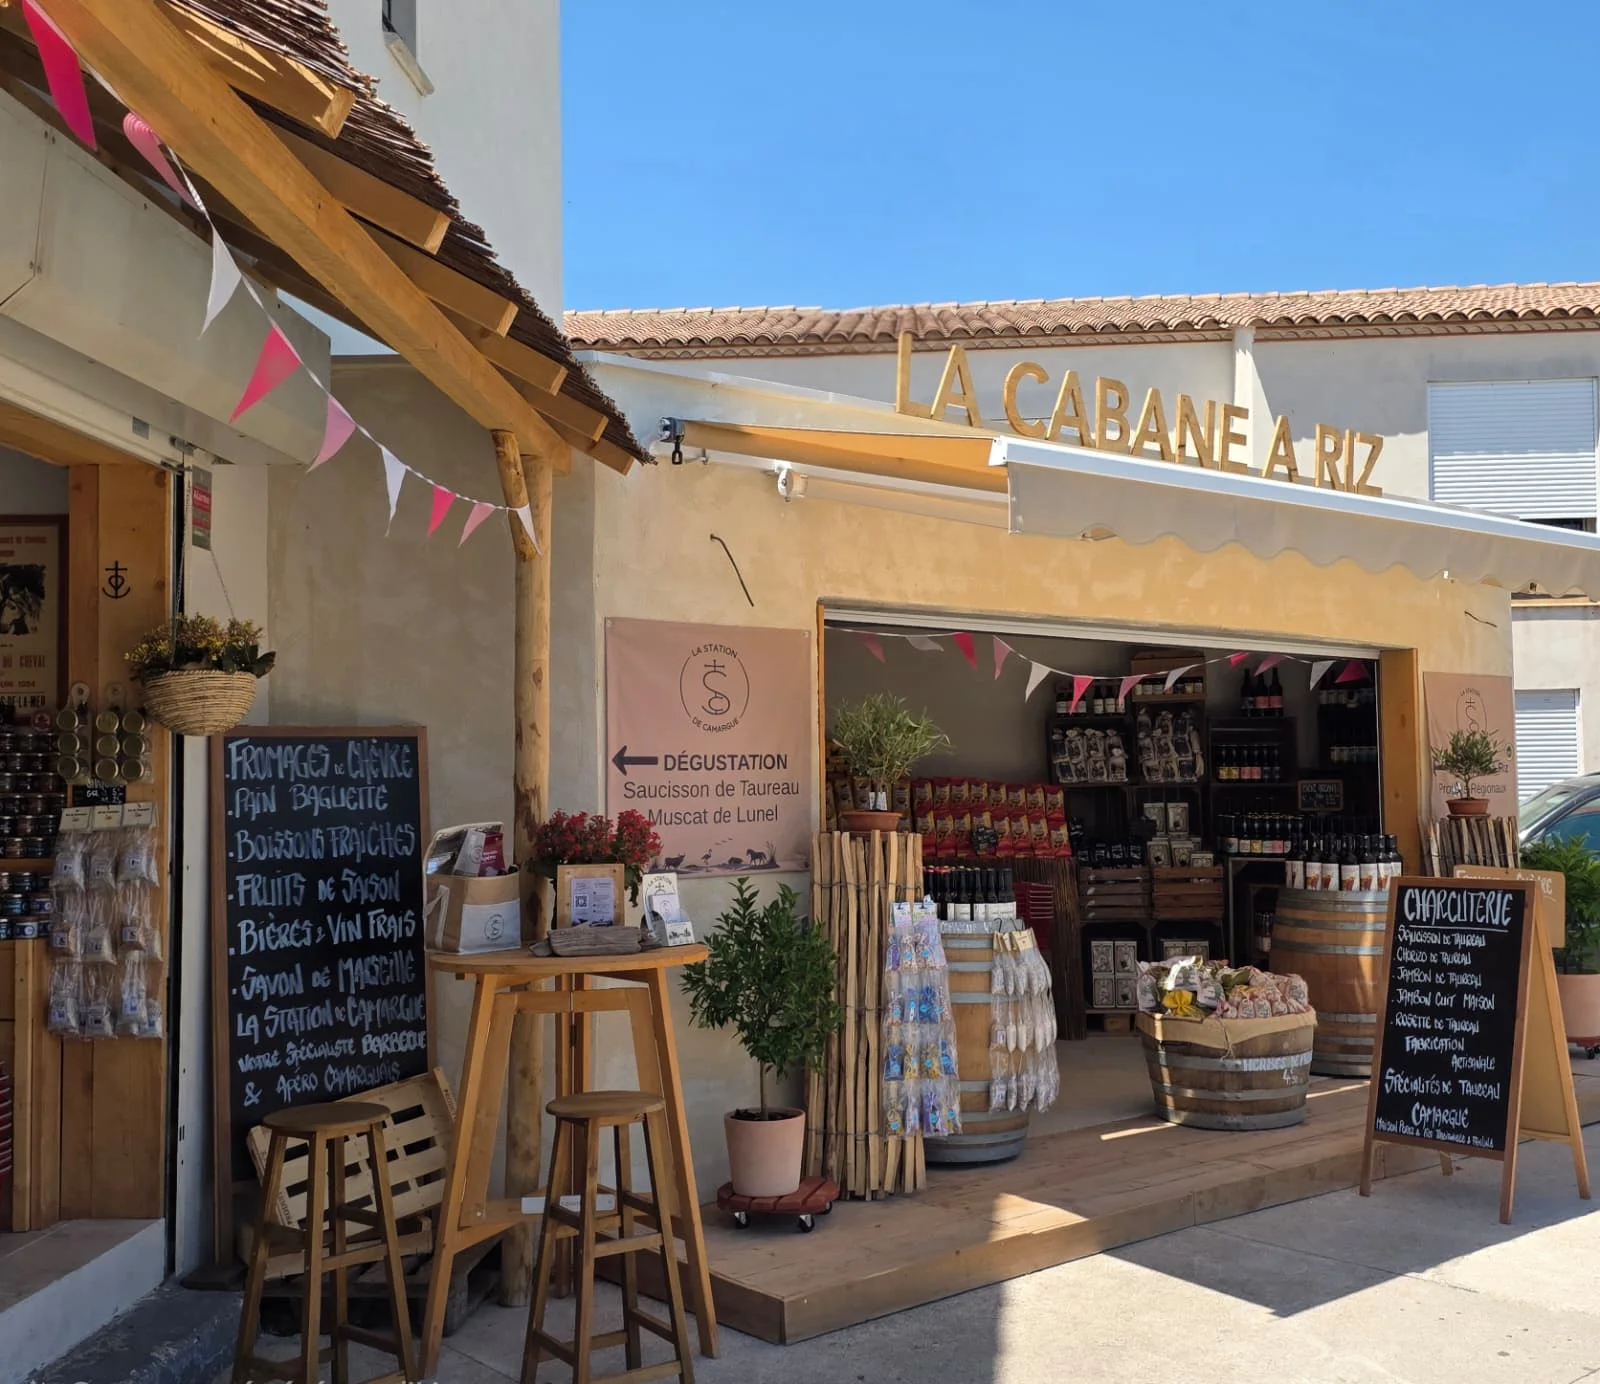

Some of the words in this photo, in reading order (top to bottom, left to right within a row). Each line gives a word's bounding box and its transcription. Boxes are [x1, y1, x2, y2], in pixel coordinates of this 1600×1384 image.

[895, 332, 983, 428] LA
[1003, 361, 1249, 475] CABANE
[1262, 415, 1299, 483] A
[1314, 423, 1384, 496] RIZ
[691, 646, 702, 656] LA
[703, 643, 737, 658] STATION
[692, 717, 703, 727] DE
[703, 717, 739, 733] CAMARGUE
[228, 738, 330, 781] FROMAGES
[664, 750, 788, 771] DÉGUSTATION
[289, 784, 388, 816] BAGUETTE
[623, 780, 710, 799] Saucisson
[715, 780, 735, 797] de
[740, 779, 799, 796] Taureau
[648, 808, 708, 825] Muscat
[713, 807, 731, 824] de
[737, 804, 778, 823] Lunel
[235, 827, 324, 862] BOISSONS
[235, 870, 307, 906] FRUITS
[318, 876, 335, 901] DE
[342, 868, 400, 904] SAISON
[1404, 888, 1513, 926] CHARCUTERIE
[327, 913, 362, 944] VIN
[368, 908, 415, 942] FRAIS
[1398, 924, 1440, 945] SAUCISSON
[1443, 934, 1452, 945] DE
[1451, 933, 1486, 949] TAUREAU
[1396, 946, 1427, 963] CHORIZO
[1430, 953, 1438, 963] DE
[1440, 951, 1471, 966] TAUREAU
[241, 963, 303, 1001] SAVON
[1397, 966, 1431, 983] JAMBON
[1435, 973, 1446, 984] DE
[1447, 972, 1482, 989] TAUREAU
[1396, 989, 1431, 1007] JAMBON
[1435, 992, 1456, 1007] CUIT
[1463, 993, 1495, 1011] MAISON
[236, 1013, 259, 1044] LA
[264, 1000, 333, 1037] STATION
[347, 994, 425, 1031] CAMARGUE
[1395, 1012, 1431, 1029] ROSETTE
[1434, 1019, 1444, 1030] DE
[1445, 1018, 1479, 1035] TAUREAU
[1404, 1035, 1464, 1056] FABRICATION
[1451, 1054, 1495, 1072] ARTISANALE
[243, 1081, 262, 1106] &
[1385, 1067, 1440, 1096] SPÉCIALITÉS
[1442, 1081, 1452, 1094] DE
[1459, 1080, 1500, 1100] TAUREAU
[1411, 1101, 1470, 1128] CAMARGUE
